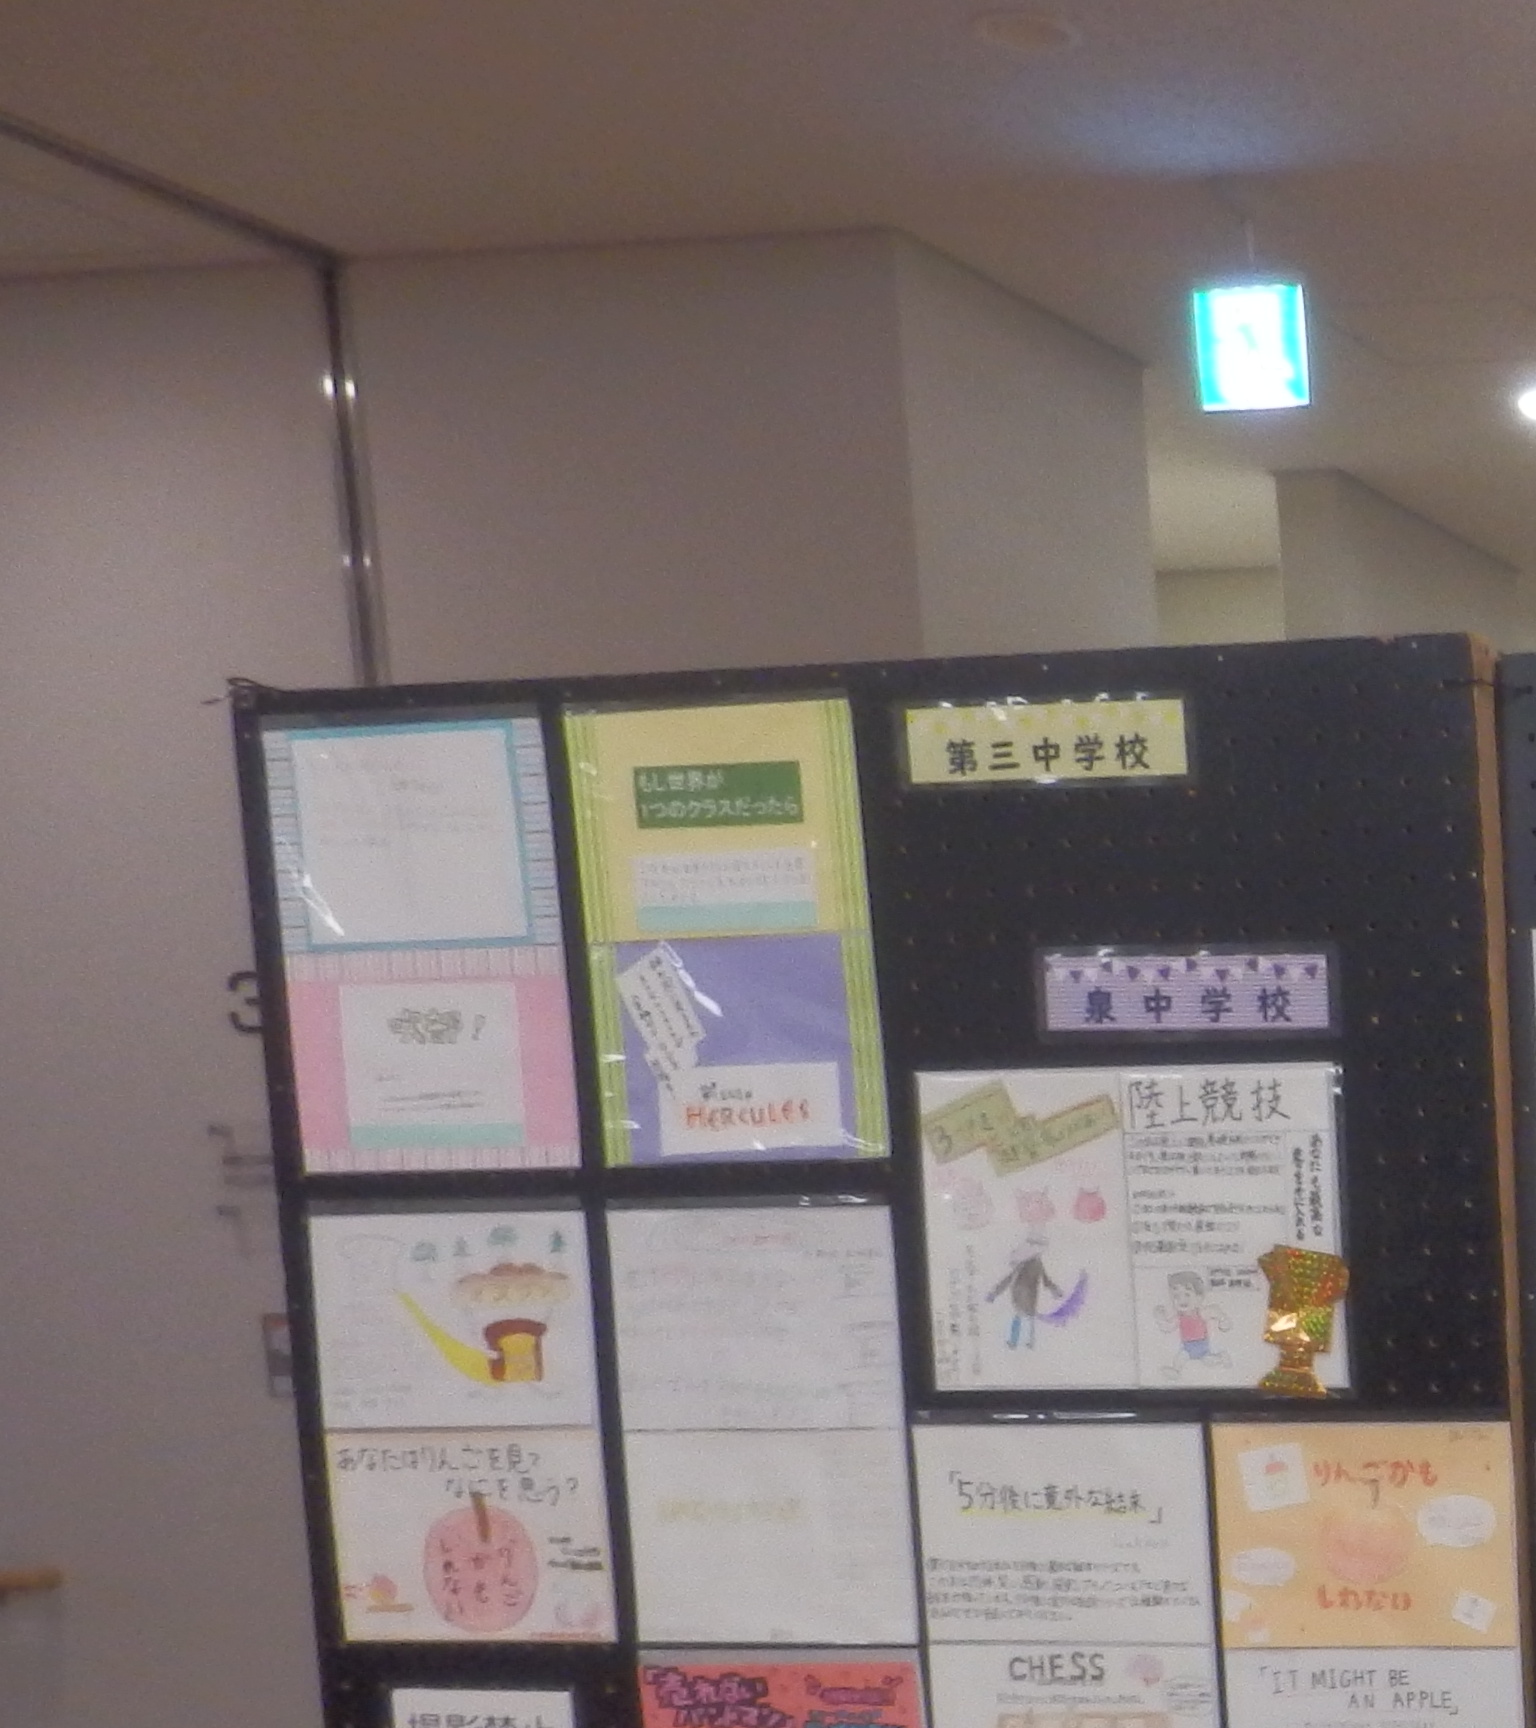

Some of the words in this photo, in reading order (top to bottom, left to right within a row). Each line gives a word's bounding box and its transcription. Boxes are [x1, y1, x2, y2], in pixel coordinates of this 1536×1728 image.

[945, 733, 1152, 776] 第三中学校
[1083, 987, 1293, 1026] 泉中学校
[1127, 1078, 1291, 1130] 陸上競技
[1009, 1651, 1106, 1683] CHESS
[1310, 1668, 1376, 1690] MIGHT
[1388, 1668, 1411, 1687] BE
[1348, 1692, 1376, 1710] AN
